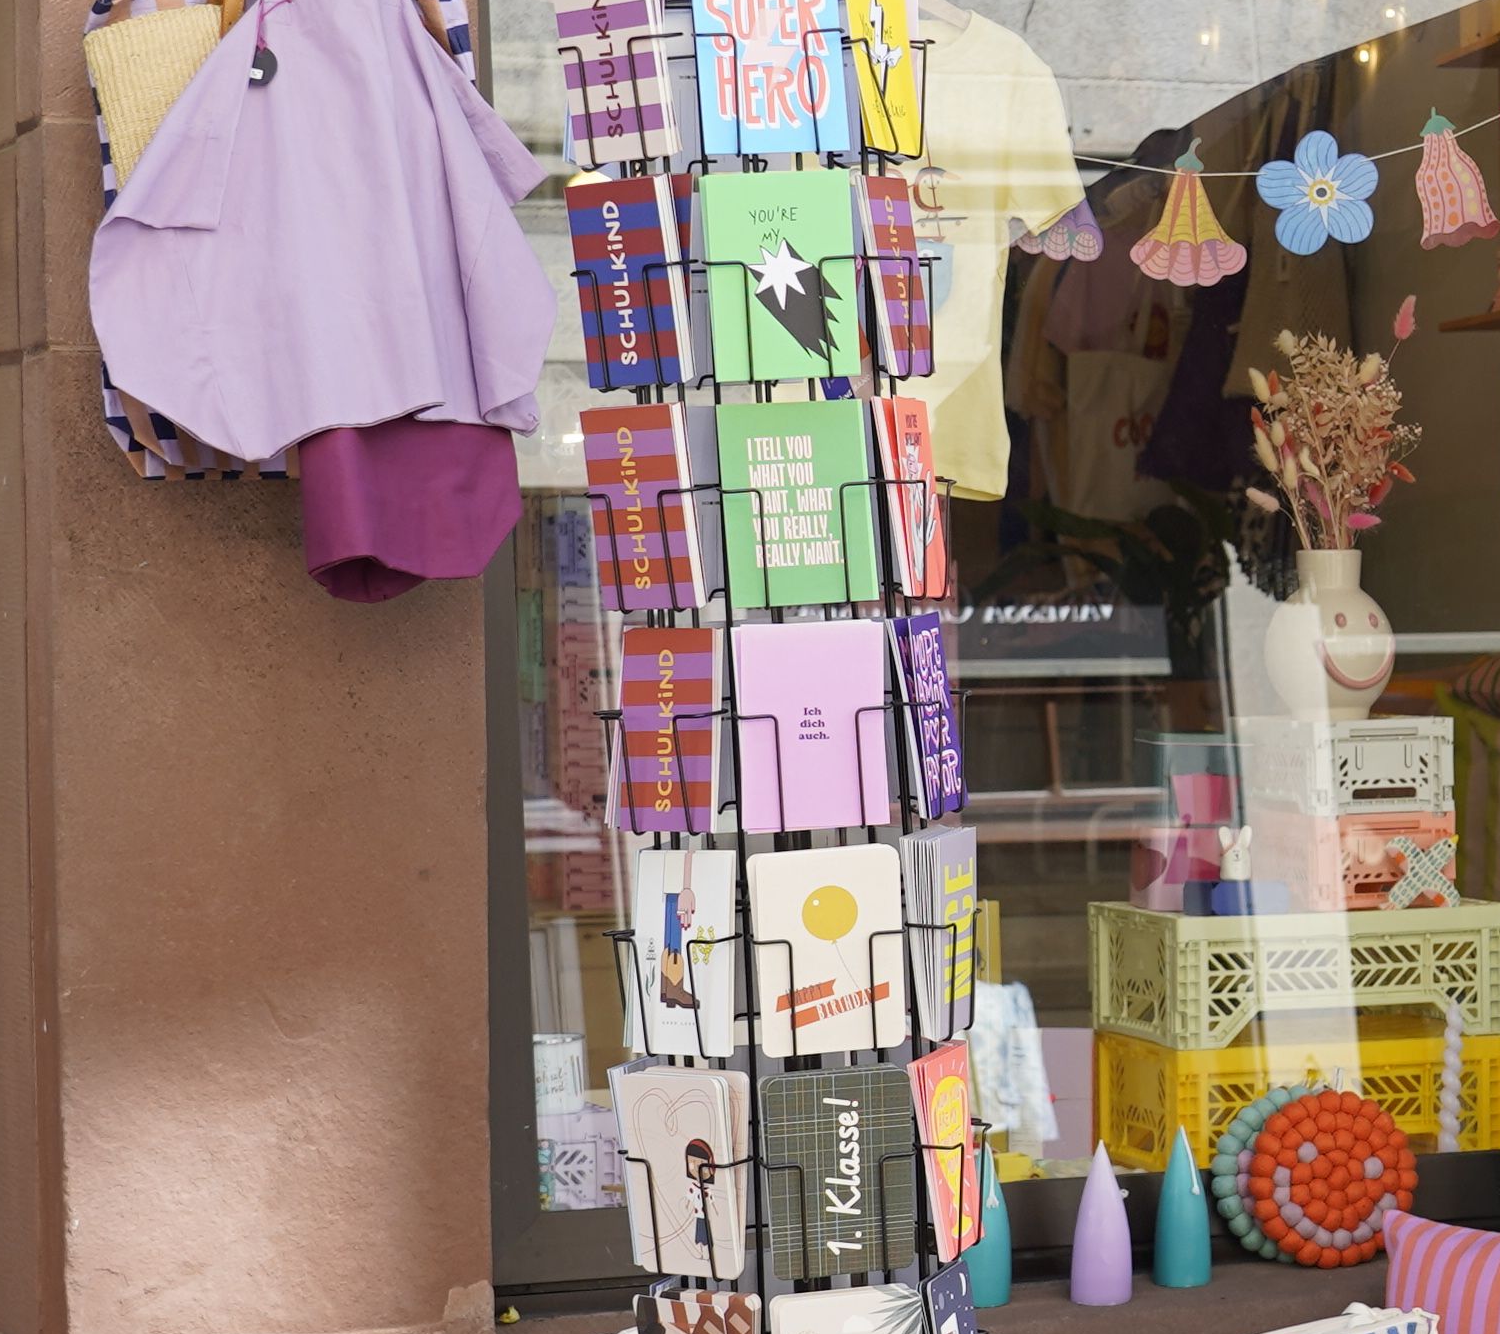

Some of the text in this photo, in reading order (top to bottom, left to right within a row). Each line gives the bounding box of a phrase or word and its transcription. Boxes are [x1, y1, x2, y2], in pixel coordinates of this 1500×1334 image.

[713, 54, 831, 131] HERO
[748, 205, 799, 226] YOU'RE
[761, 227, 780, 245] MY
[746, 434, 813, 462] I TELL YOU
[748, 461, 814, 488] WHAT YOU
[750, 487, 834, 516] WANT, WHAT
[752, 514, 834, 542] YOU REALLY,
[755, 539, 845, 569] REALLY WANT.
[800, 719, 826, 728] dich
[803, 707, 822, 716] Ich
[798, 731, 830, 740] auch.
[943, 856, 974, 1005] NICE
[822, 1096, 863, 1257] 1. Klasse!
